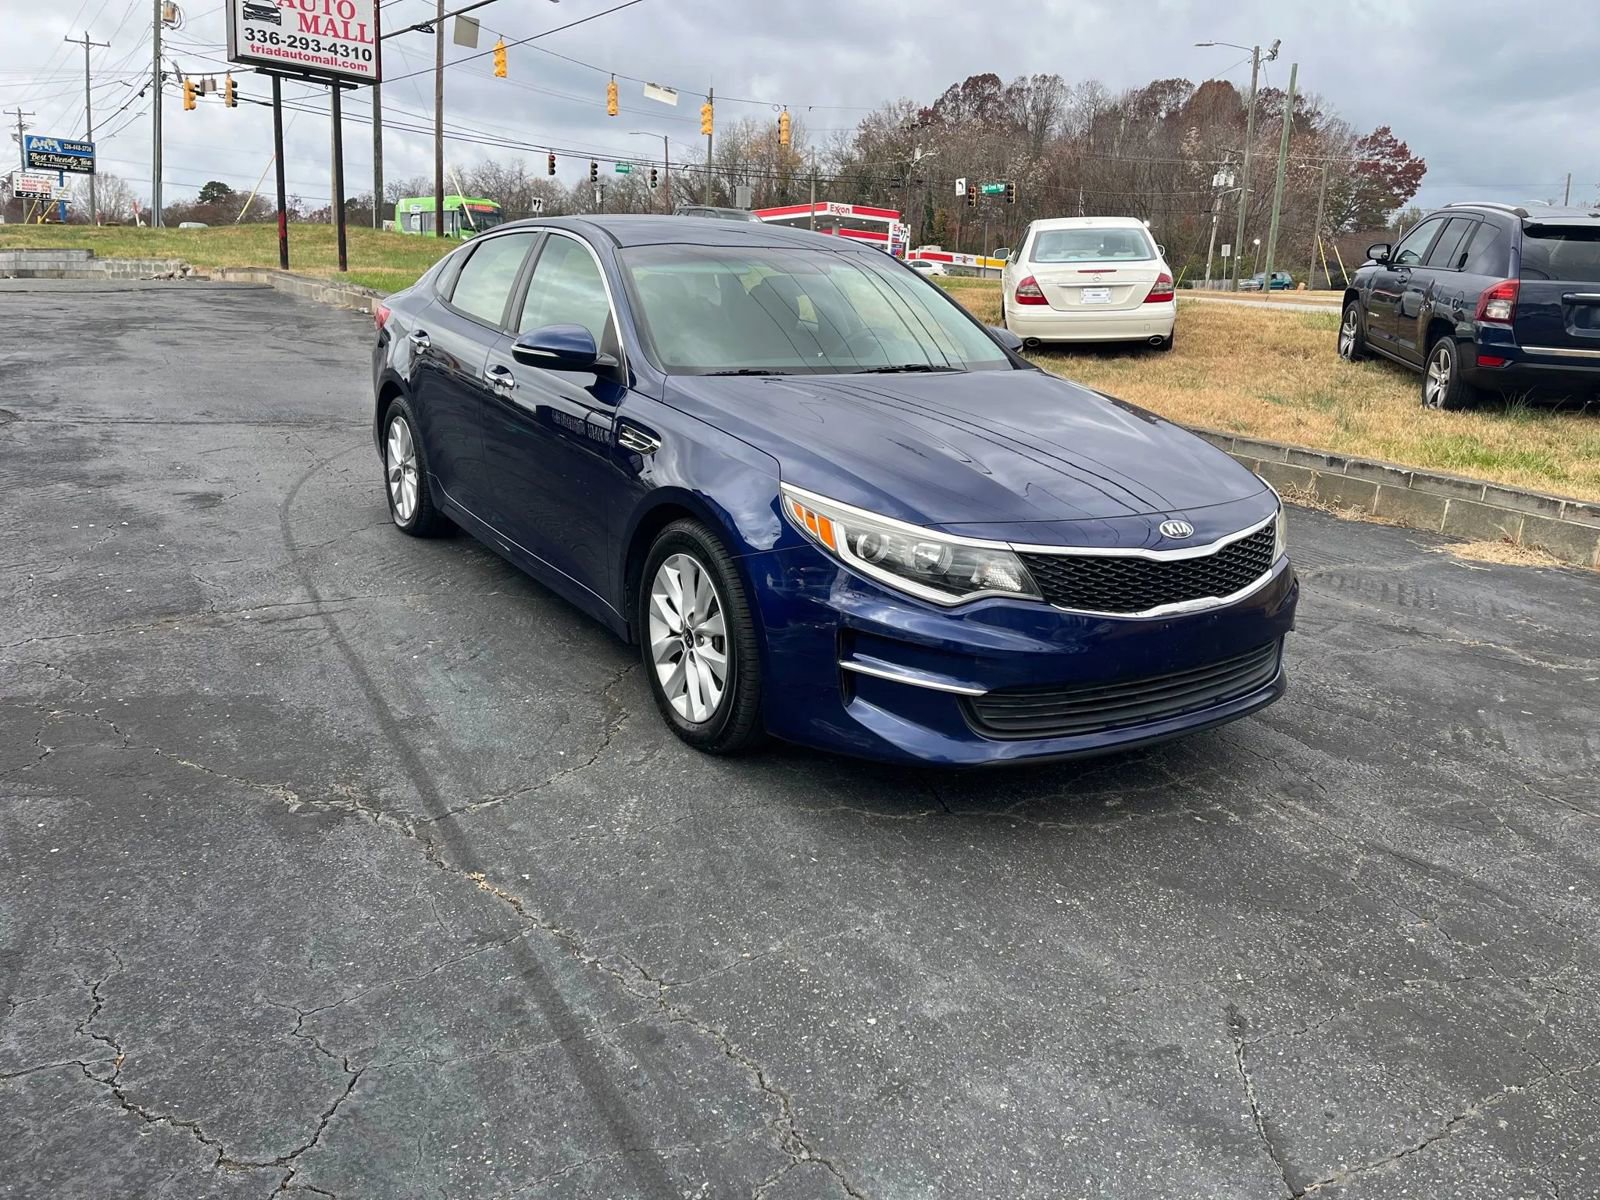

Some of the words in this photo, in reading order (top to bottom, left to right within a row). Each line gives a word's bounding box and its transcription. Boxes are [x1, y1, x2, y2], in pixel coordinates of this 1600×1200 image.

[297, 12, 374, 44] MALL
[244, 27, 372, 62] 336-293-4310
[250, 43, 368, 72] triadautomall.com
[30, 152, 47, 161] Best
[830, 203, 850, 215] Exxon
[1164, 521, 1191, 535] KIA
